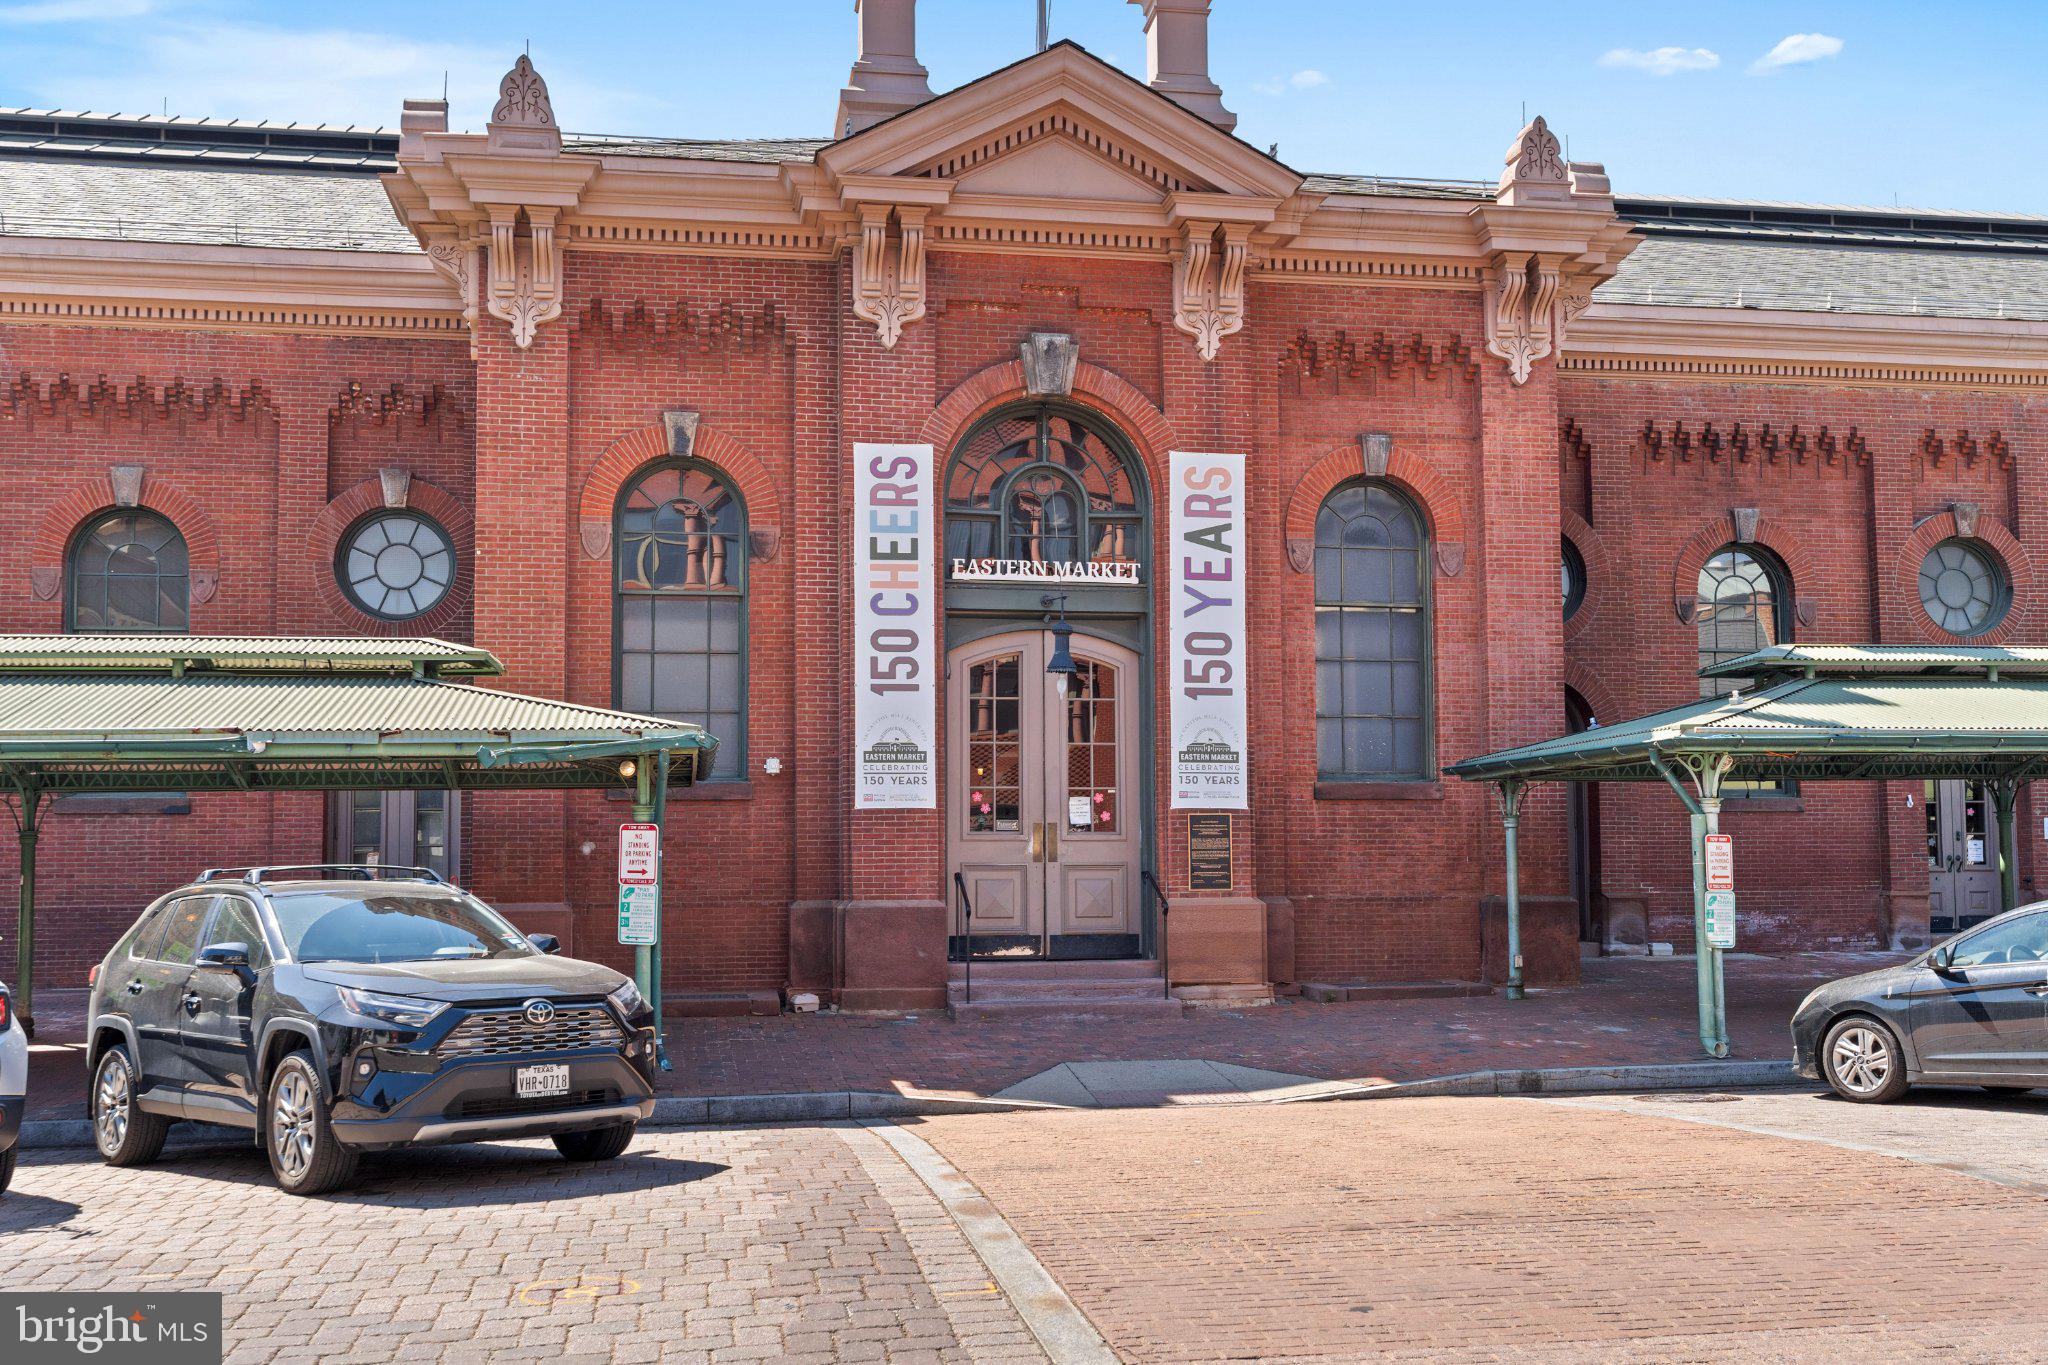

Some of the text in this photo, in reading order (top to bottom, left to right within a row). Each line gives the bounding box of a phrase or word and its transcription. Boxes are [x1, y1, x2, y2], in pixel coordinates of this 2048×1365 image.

[869, 456, 919, 617] CHEERS
[1183, 466, 1232, 619] YEARS
[952, 558, 1141, 580] EASTERN MARKET
[869, 628, 920, 697] 150
[1183, 631, 1233, 701] 150
[865, 753, 925, 761] EASTERN MARKET
[1180, 753, 1237, 761] EASTERN MARKET
[863, 776, 928, 785] 150 YEARS
[1178, 775, 1240, 785] 150 YEARS
[627, 841, 650, 849] STANDING
[632, 850, 652, 858] PARKING
[533, 1066, 554, 1074] TEXAS
